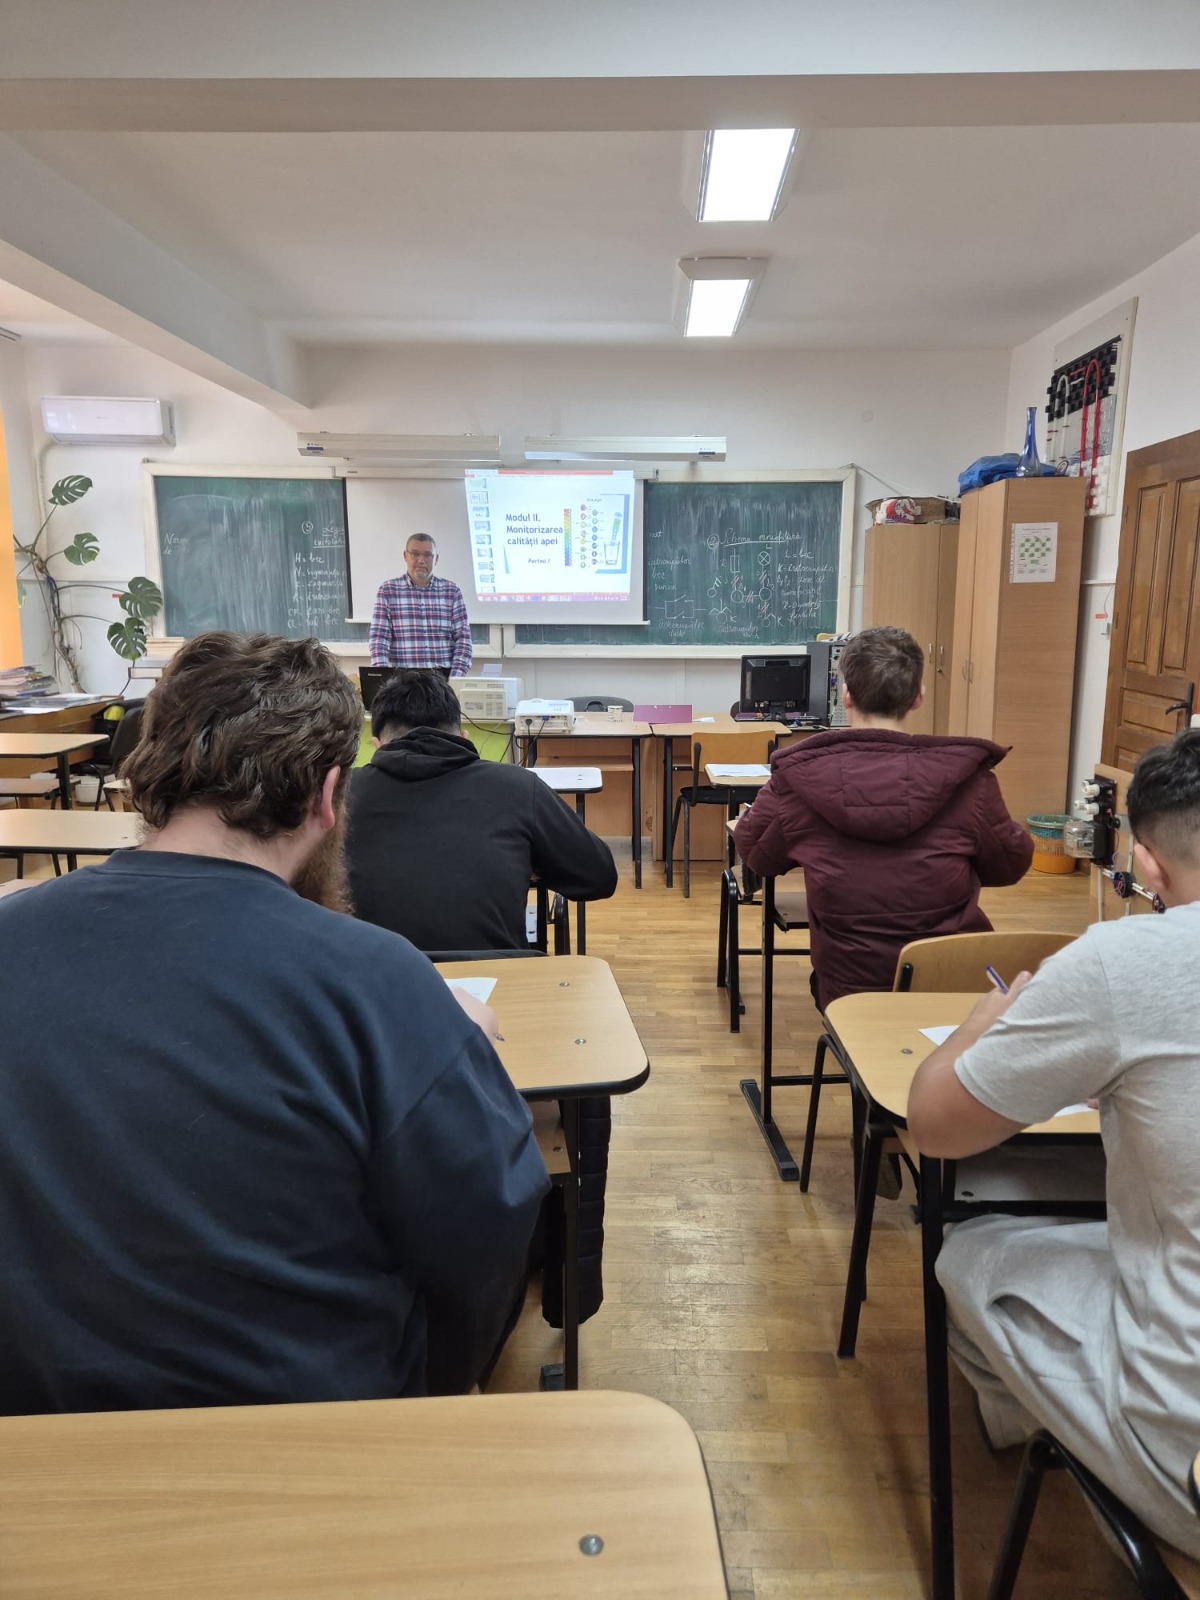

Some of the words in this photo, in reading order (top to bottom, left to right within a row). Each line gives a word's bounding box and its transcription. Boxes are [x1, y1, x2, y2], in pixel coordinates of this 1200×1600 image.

[506, 513, 531, 522] Modul
[532, 513, 541, 522] II.
[506, 525, 563, 534] Monitorizarea
[540, 537, 558, 547] apei
